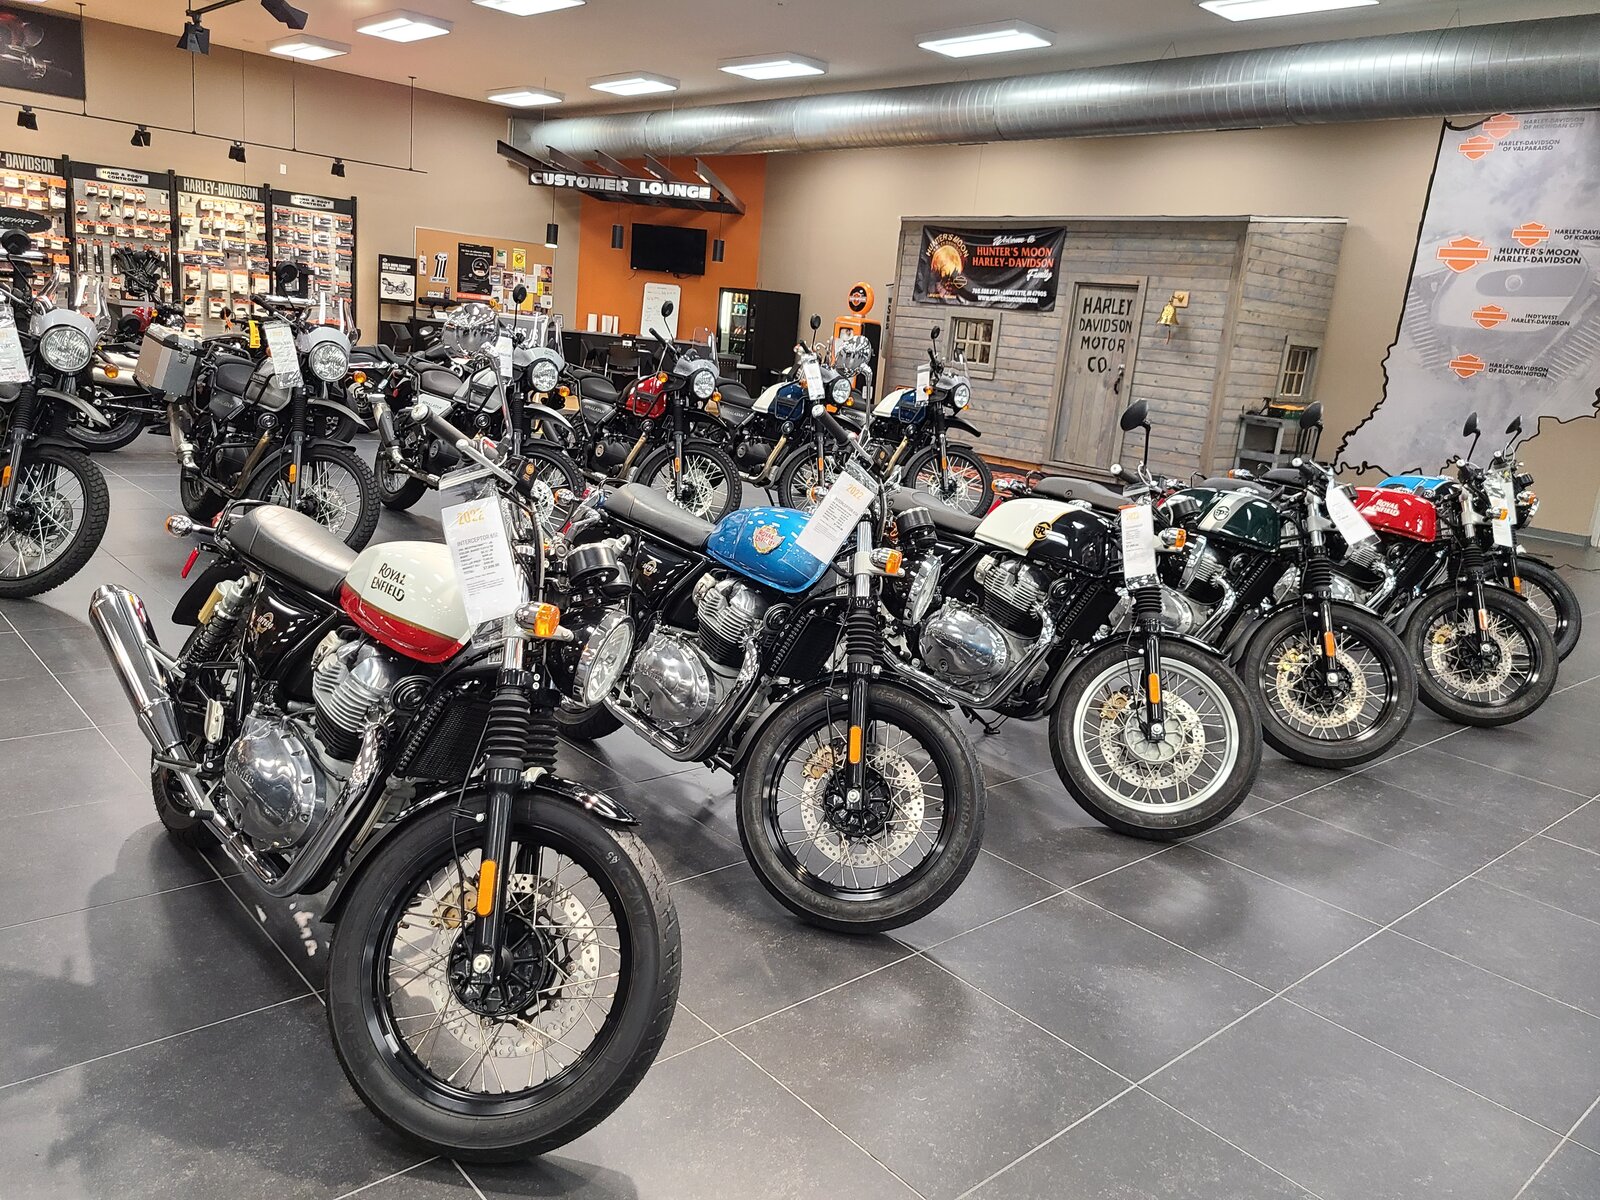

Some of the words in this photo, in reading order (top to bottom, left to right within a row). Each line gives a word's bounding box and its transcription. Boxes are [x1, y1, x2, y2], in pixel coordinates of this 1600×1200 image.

[1523, 117, 1585, 125] HARLEY-DAVIDSON
[107, 175, 139, 183] CONTROLS
[183, 178, 259, 201] HARLEY-DAVIDSON
[530, 172, 629, 193] CUSTOMER
[639, 181, 711, 200] LOUNGE
[925, 233, 954, 257] HUNTER'S
[953, 236, 970, 257] MOON
[977, 246, 1019, 256] HUNTER'S
[1021, 247, 1053, 257] MOON
[1499, 247, 1544, 256] HUNTER'S
[1546, 248, 1580, 256] MOON
[972, 256, 1055, 268] HARLEY-DAVIDSON
[1493, 255, 1582, 264] HARLEY-DAVIDSON
[1083, 296, 1133, 316] HARLEY
[1079, 317, 1133, 334] DAVIDSON
[1511, 317, 1571, 326] HARLEY-DAVIDSON
[1080, 335, 1126, 354] MOTOR
[1087, 356, 1111, 373] CO.
[1488, 362, 1549, 373] HARLEY-DAVIDSON
[1498, 368, 1548, 378] BLOOMINGTON
[847, 484, 864, 500] 2022
[1376, 499, 1399, 509] ROYAL
[457, 535, 490, 547] INTERCEPTOR
[378, 562, 406, 586] ROYAL
[370, 576, 406, 602] ENFIELD
